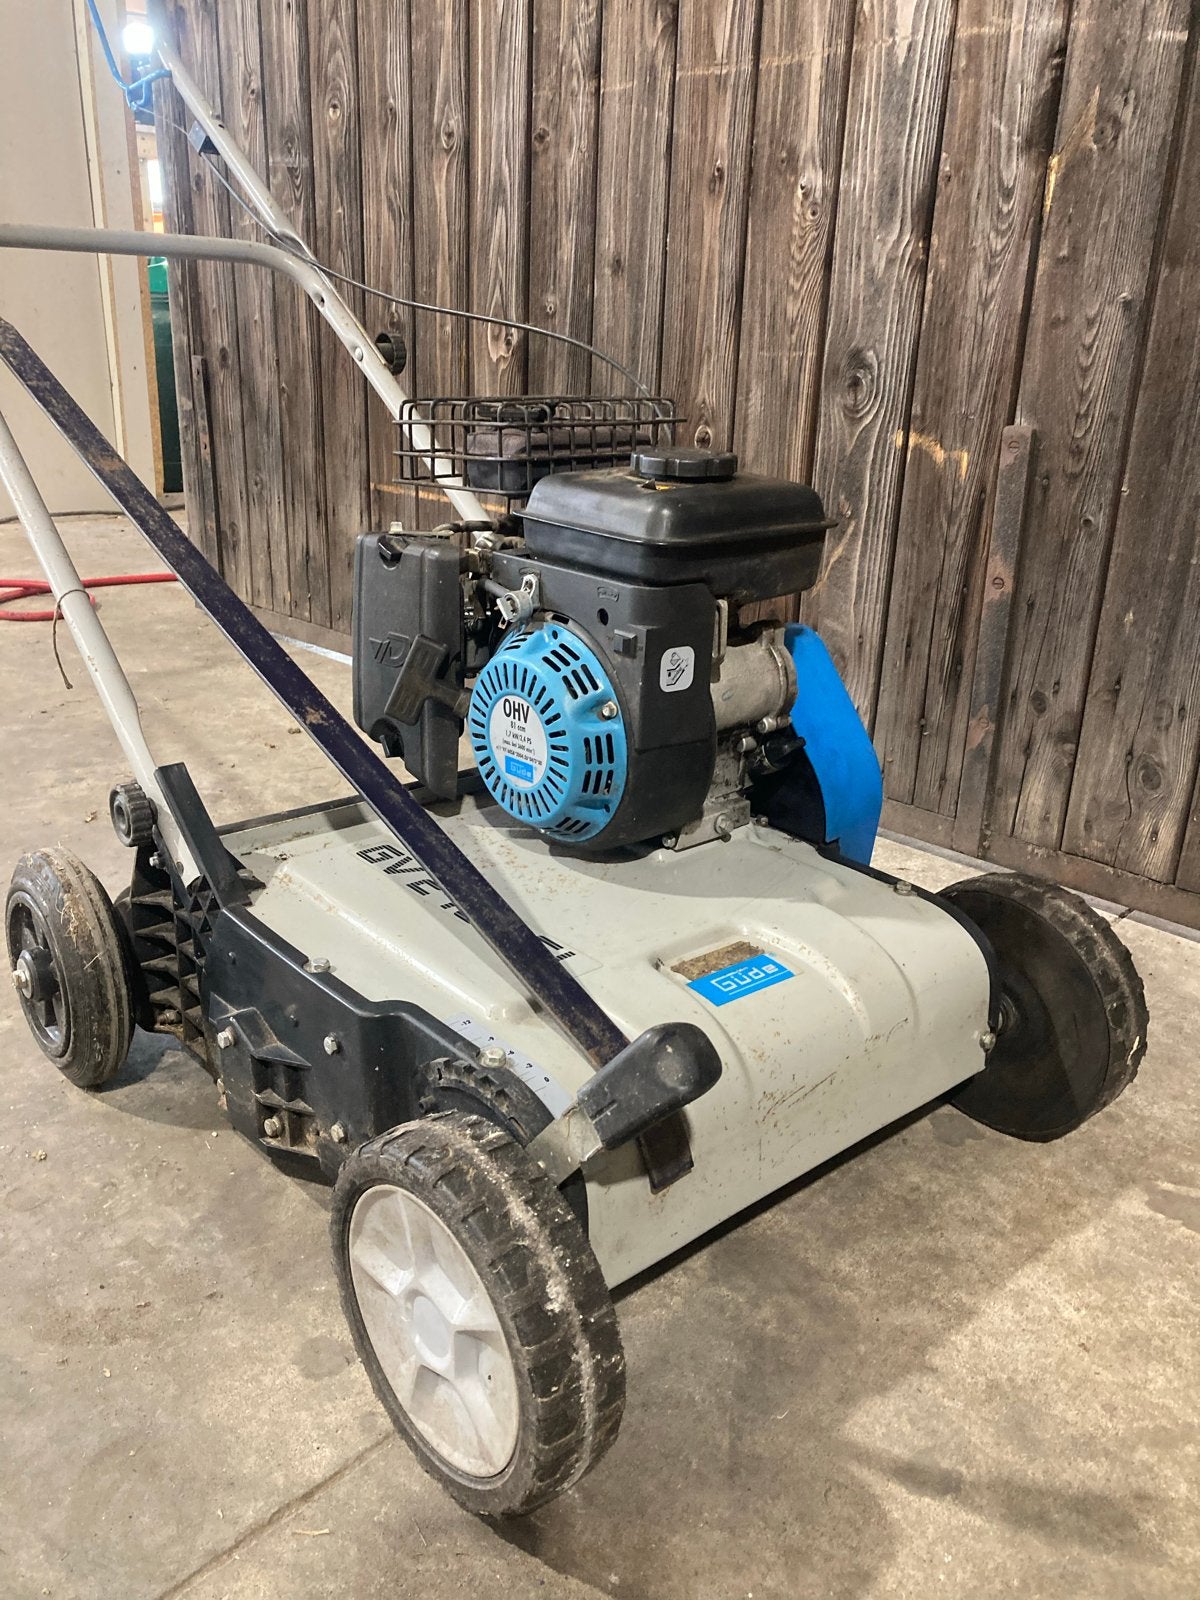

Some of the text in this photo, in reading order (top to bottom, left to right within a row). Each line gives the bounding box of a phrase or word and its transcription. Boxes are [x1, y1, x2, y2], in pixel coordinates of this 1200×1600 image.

[503, 698, 530, 723] OHV
[510, 720, 517, 729] 81
[356, 844, 425, 875] GV
[710, 964, 778, 992] Güde
